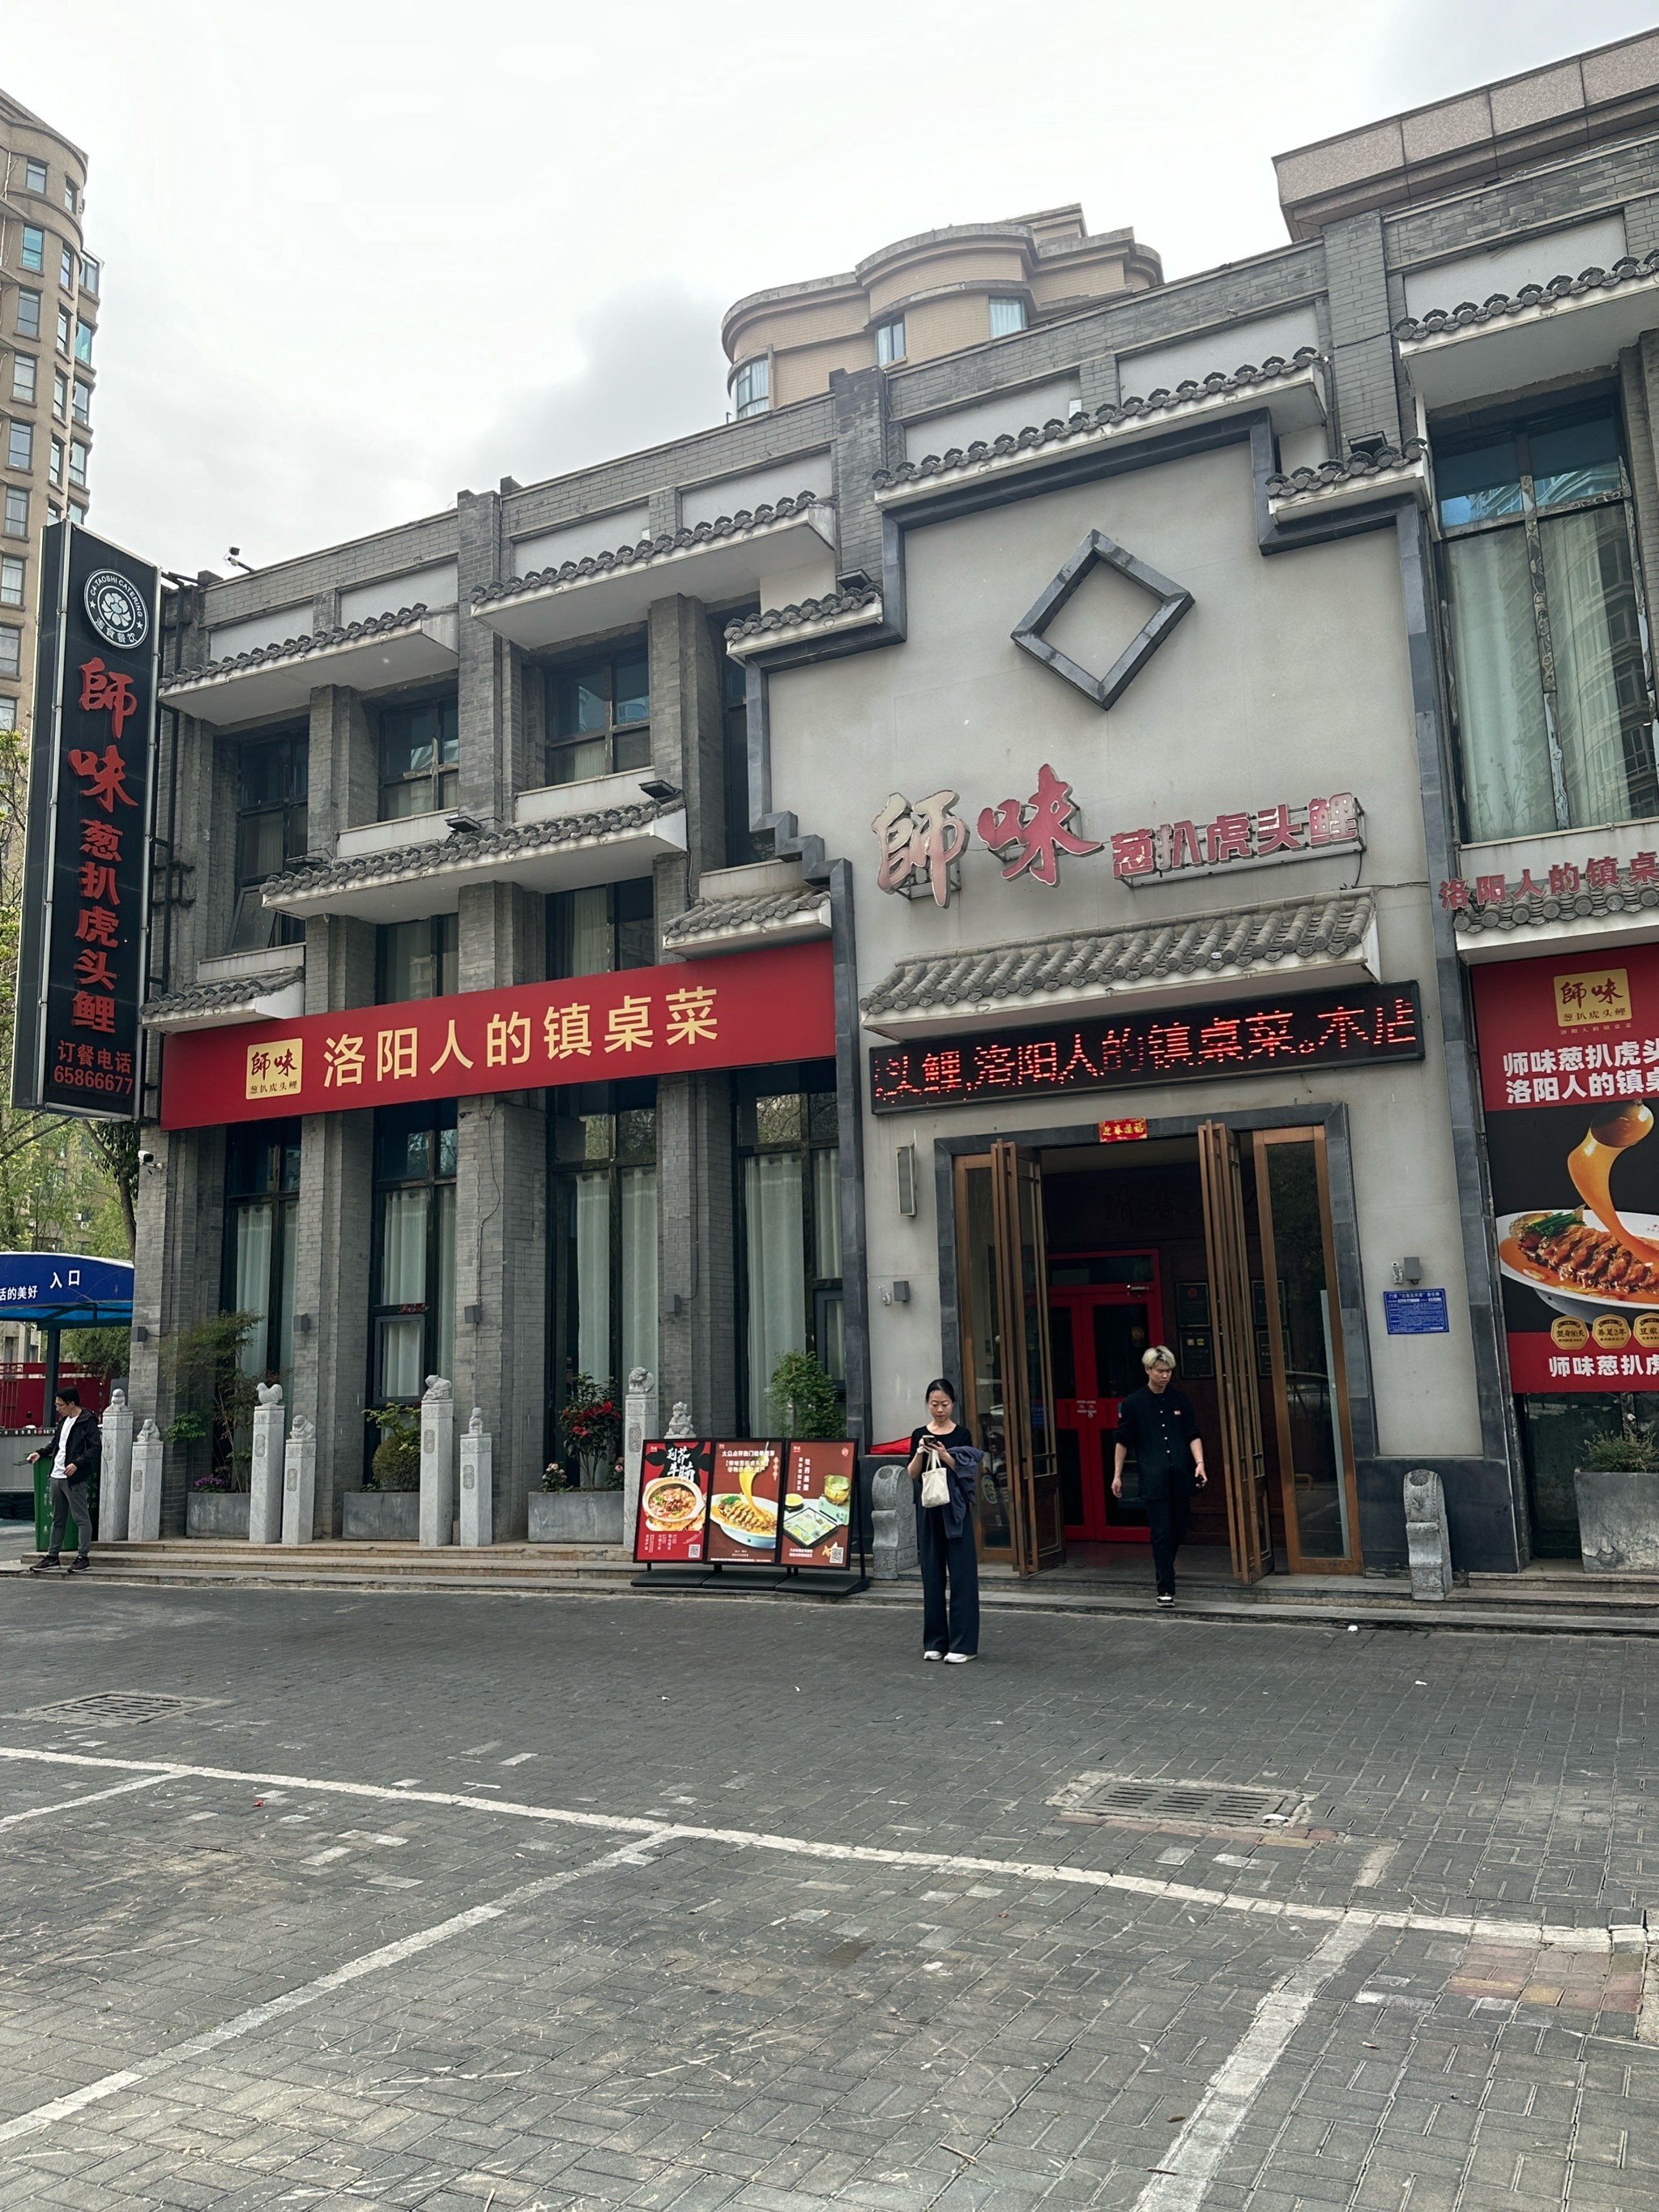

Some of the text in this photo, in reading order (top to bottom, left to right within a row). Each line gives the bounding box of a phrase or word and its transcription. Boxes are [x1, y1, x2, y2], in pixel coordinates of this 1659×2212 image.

[1110, 792, 1361, 879] 葱扒虎头鲤
[71, 818, 124, 1035] 葱扒虎头鲤
[1563, 1007, 1627, 1023] 葱扒虎头鲤
[324, 985, 719, 1088] 洛阳人的镇桌菜
[58, 1040, 132, 1075] 订餐电话
[53, 1065, 134, 1095] 65866677
[249, 1079, 298, 1095] 葱扒虎头鲤
[49, 1270, 80, 1289] 入口
